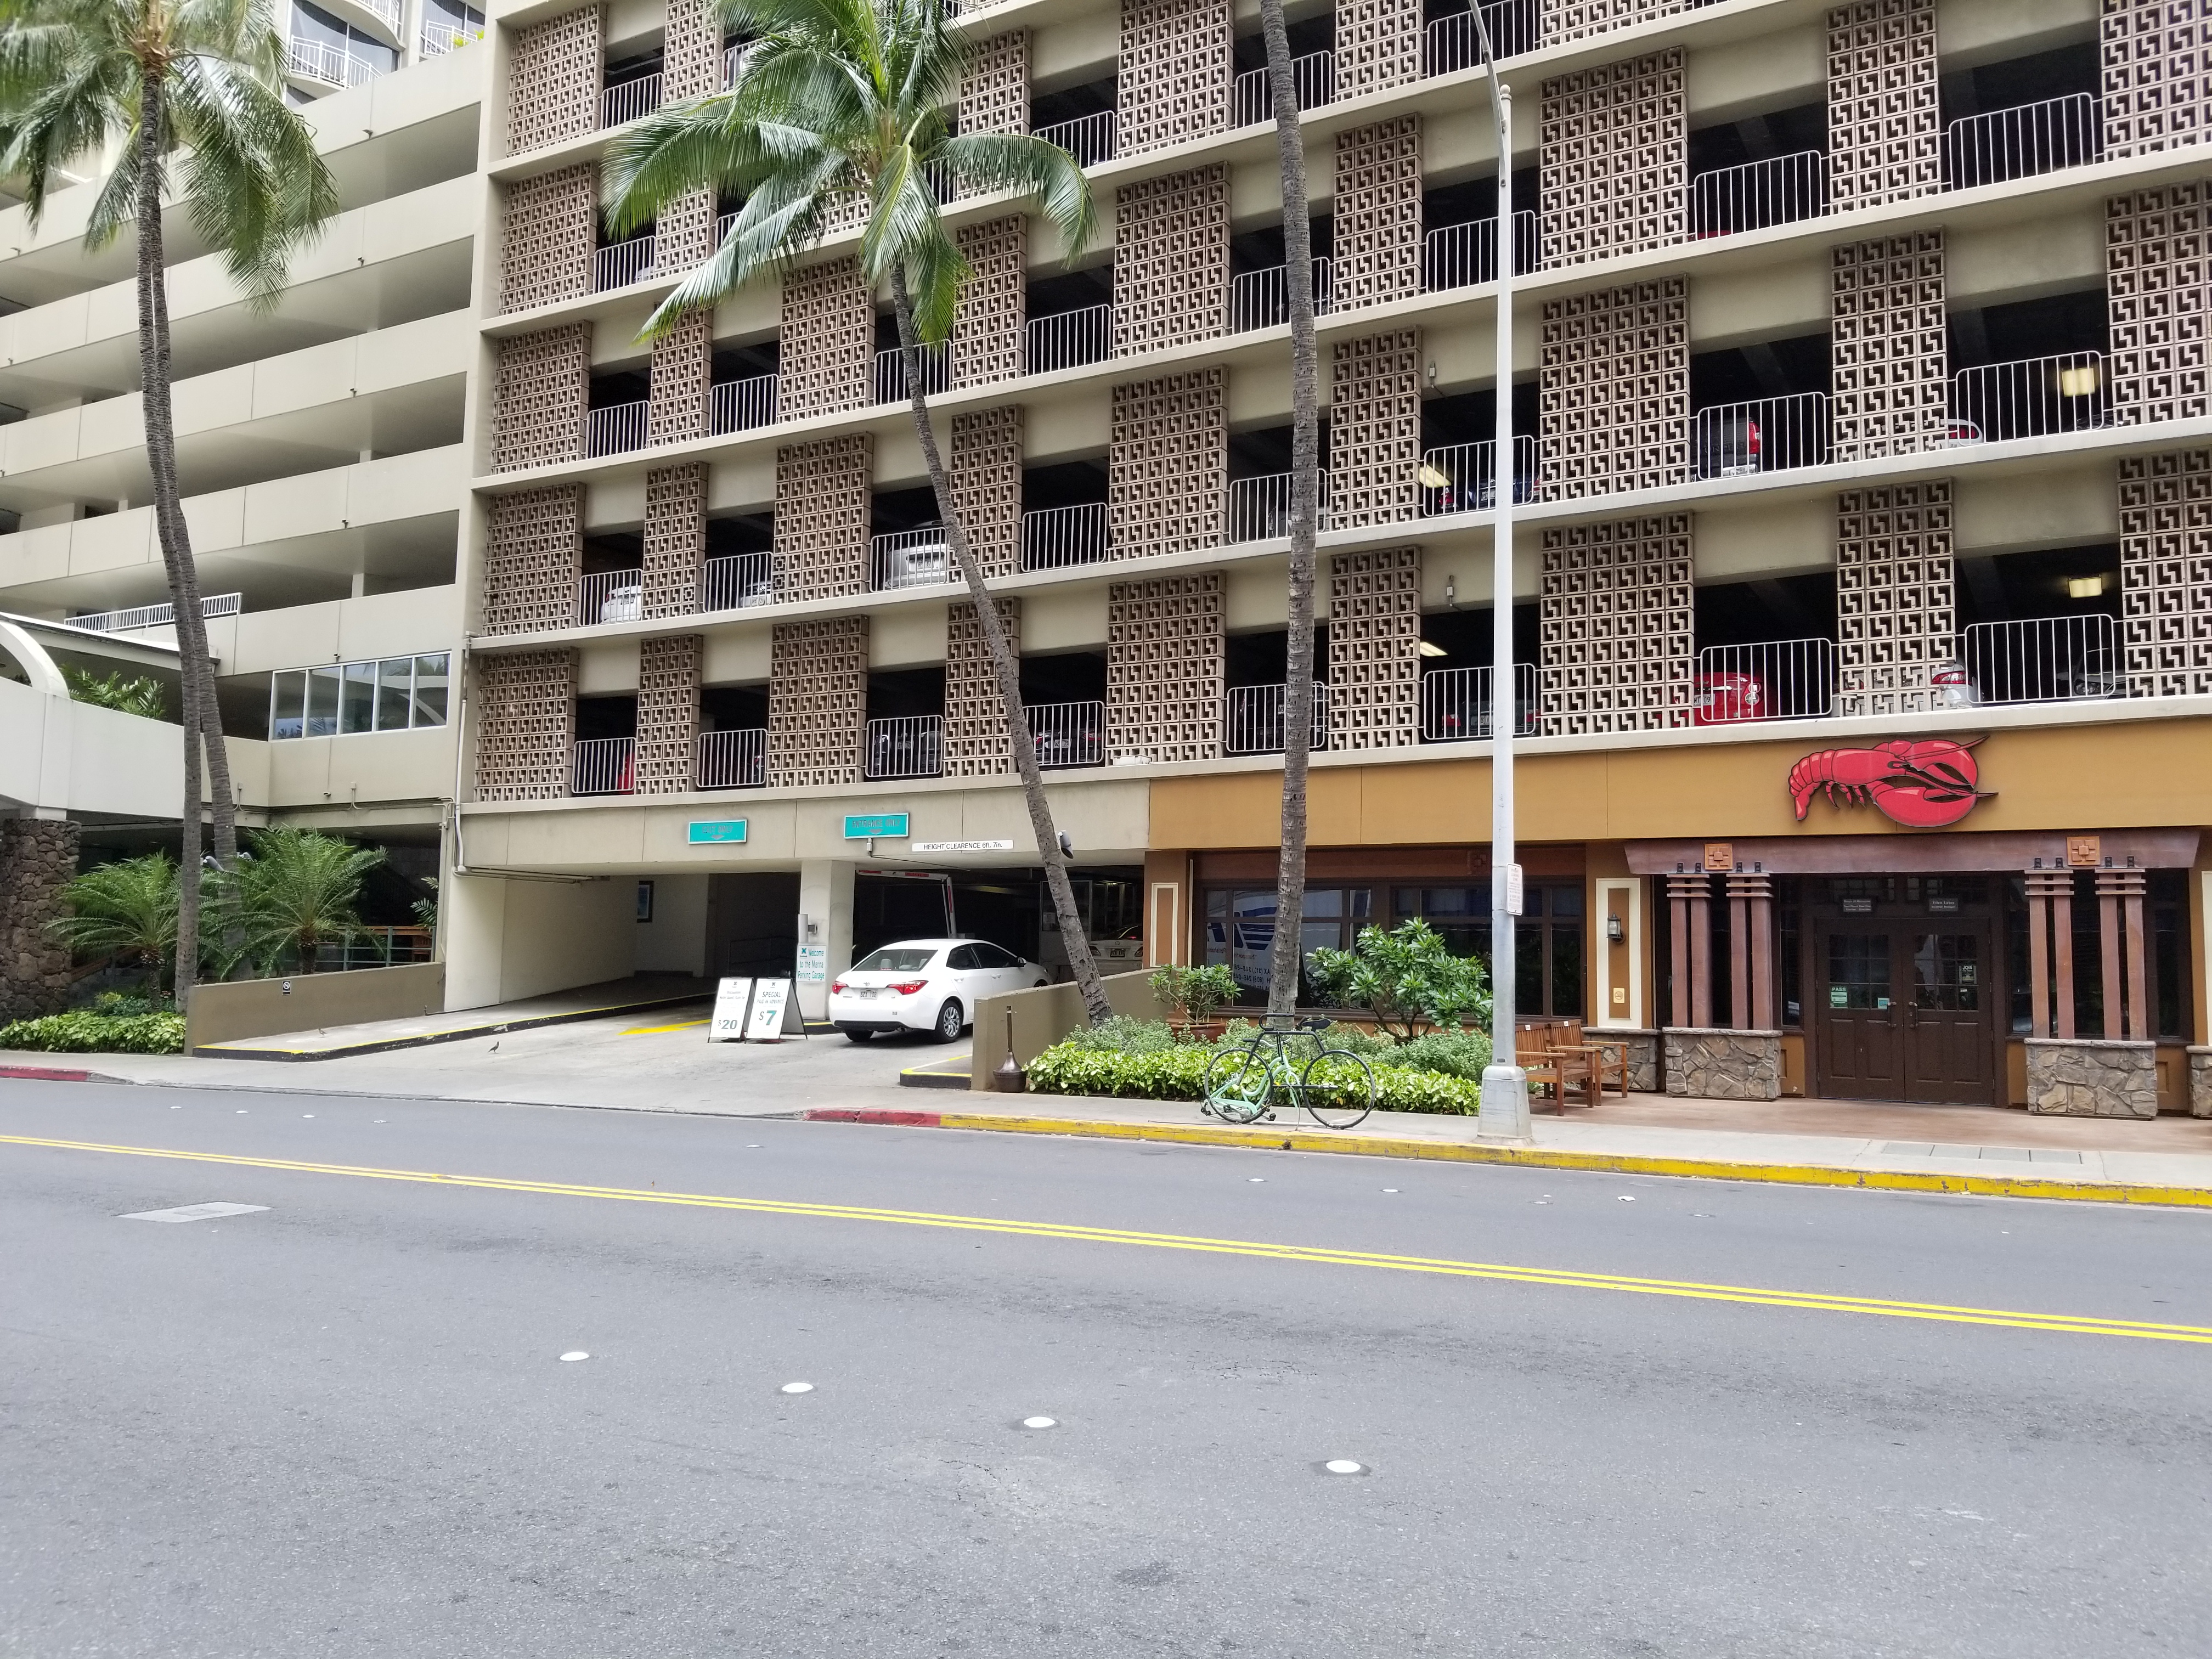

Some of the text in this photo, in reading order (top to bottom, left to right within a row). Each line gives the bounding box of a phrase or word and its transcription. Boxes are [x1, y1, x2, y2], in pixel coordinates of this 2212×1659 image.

[852, 818, 901, 828] ENTRANCE ONLY
[718, 825, 733, 833] ONLY
[808, 948, 824, 957] Welcome
[812, 960, 824, 968] Marina
[798, 970, 825, 981] Parking Garage
